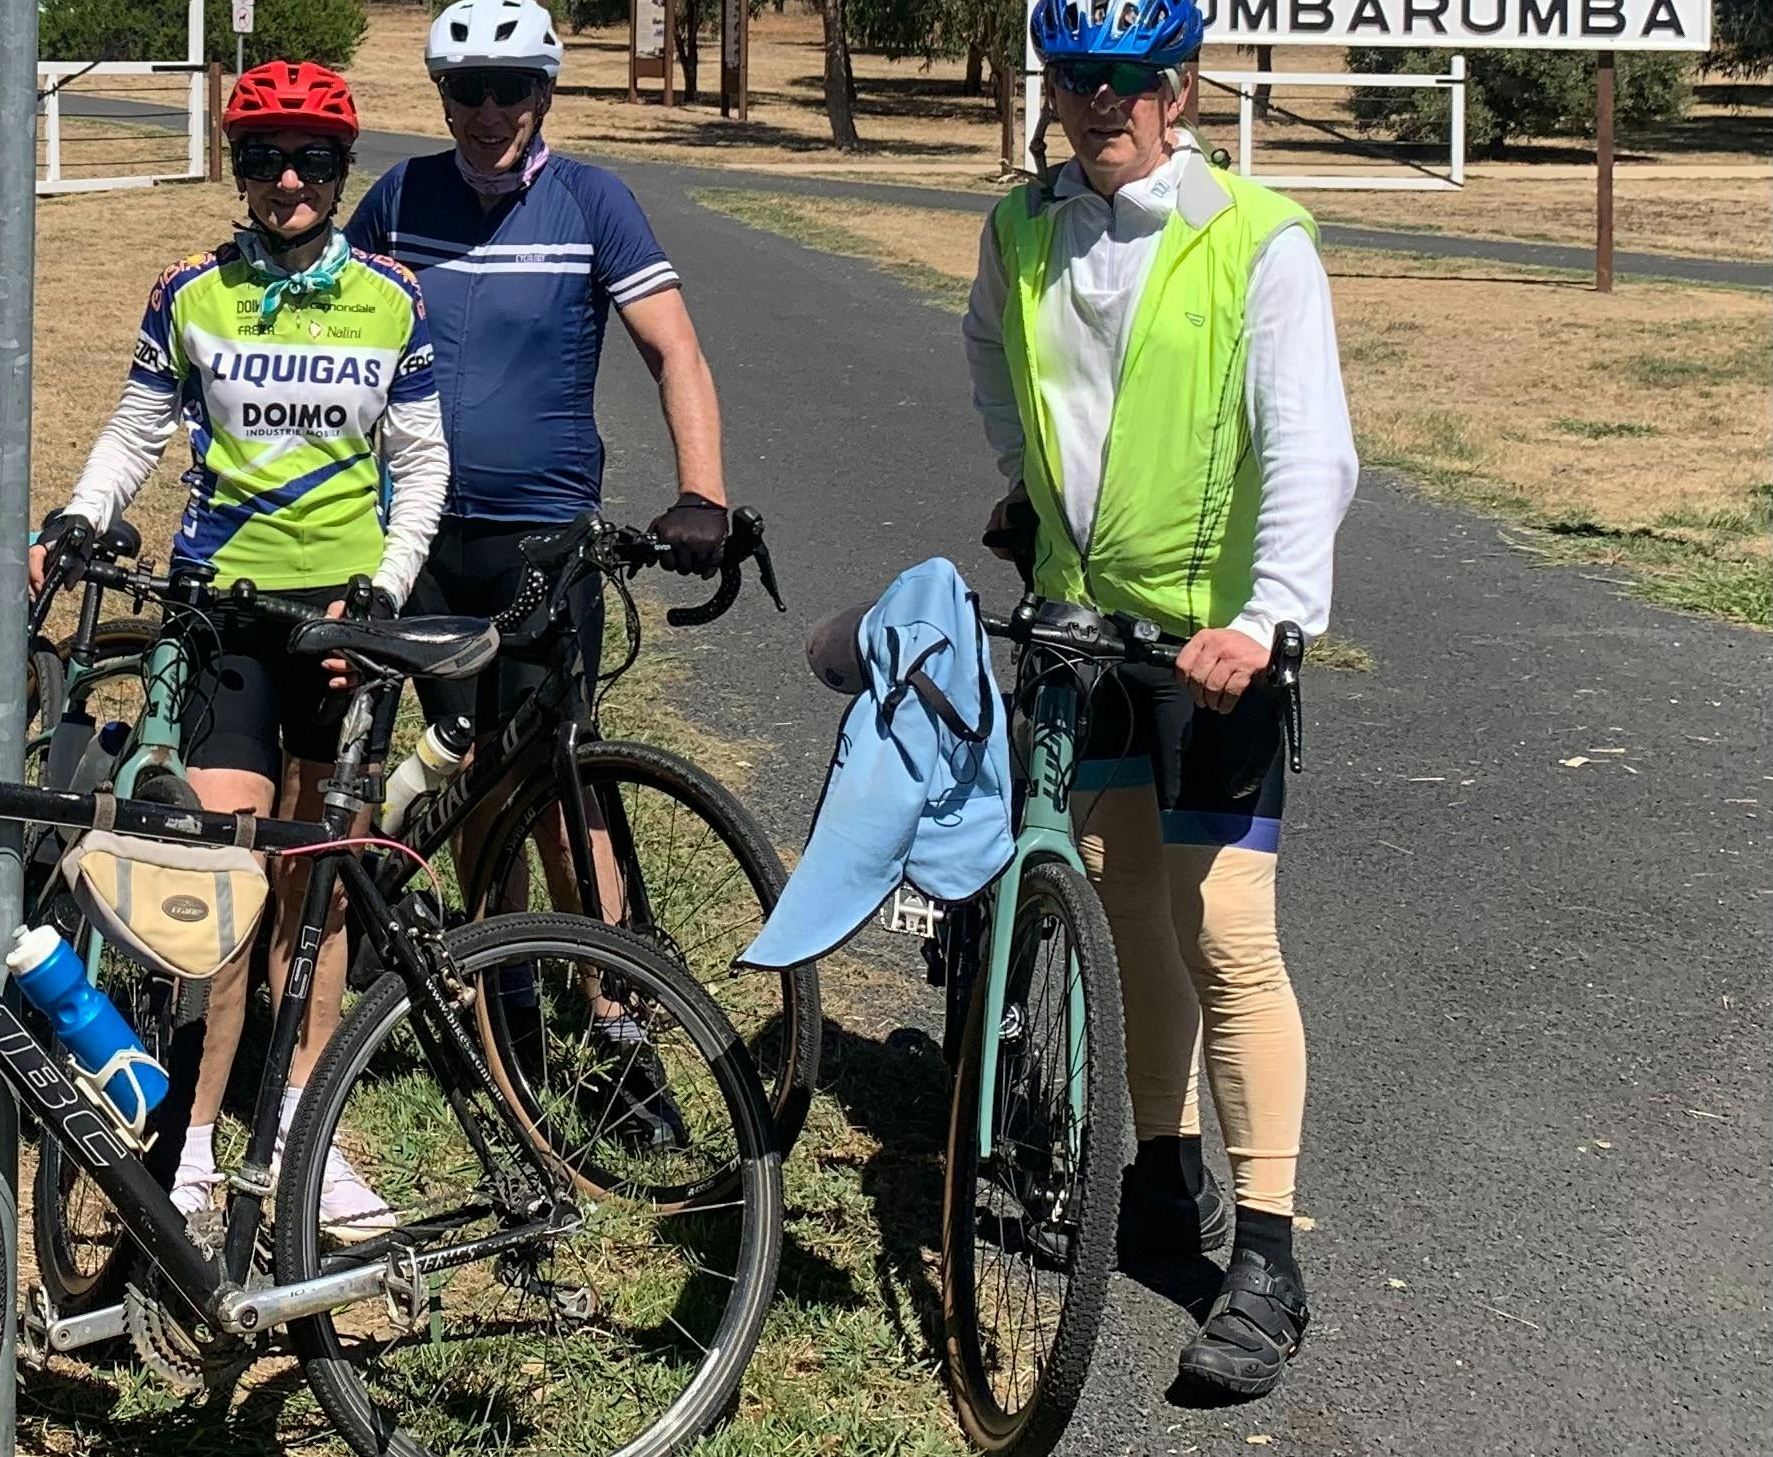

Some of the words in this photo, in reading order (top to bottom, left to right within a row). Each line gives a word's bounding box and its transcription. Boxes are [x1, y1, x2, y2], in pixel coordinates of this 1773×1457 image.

[327, 326, 363, 339] Nalini
[212, 353, 381, 388] LIQUIGAS
[242, 402, 347, 428] DOIMO
[246, 428, 301, 437] INDUSTRIE
